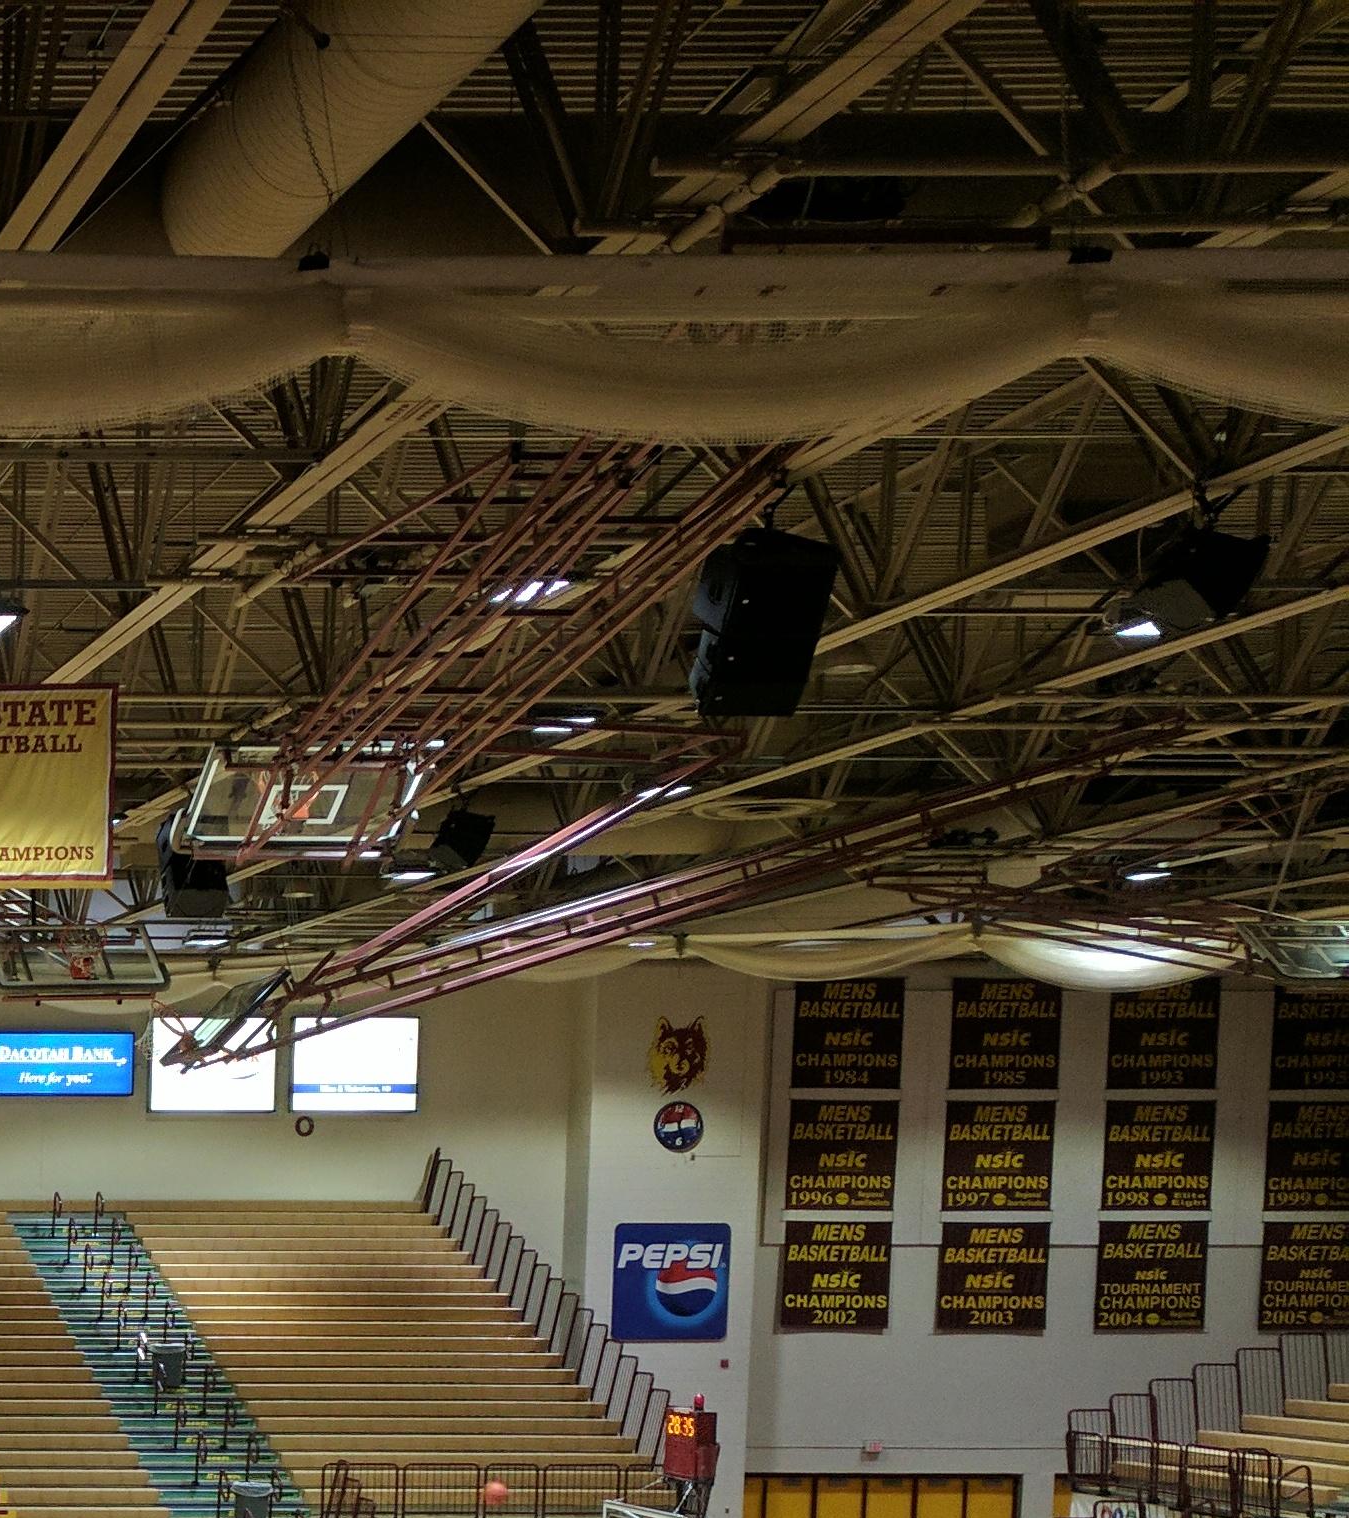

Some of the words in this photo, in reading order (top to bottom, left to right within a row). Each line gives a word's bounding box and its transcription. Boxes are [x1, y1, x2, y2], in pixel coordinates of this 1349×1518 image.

[823, 982, 877, 1000] MENS
[981, 982, 1035, 1000] MENS
[798, 1000, 901, 1018] BASKETBALL
[956, 1000, 1057, 1018] BASKETBALL
[1113, 1002, 1217, 1019] BASKETBALL
[72, 1045, 115, 1061] BANK
[796, 1053, 899, 1068] CHAMPIONS
[953, 1053, 1057, 1069] CHAMPIONS
[1111, 1053, 1215, 1068] CHAMPIONS
[18, 1071, 45, 1084] Here
[824, 1070, 870, 1085] 1984
[982, 1070, 1027, 1085] 1985
[817, 1105, 872, 1122] MENS
[974, 1105, 1028, 1122] MENS
[1133, 1104, 1189, 1122] MENS
[294, 1115, 315, 1137] O
[792, 1123, 894, 1141] BASKETBALL
[949, 1123, 1051, 1141] BASKETBALL
[1108, 1125, 1211, 1142] BASKETBALL
[790, 1175, 892, 1190] CHAMPIONS
[946, 1175, 1049, 1190] CHAMPIONS
[1106, 1176, 1209, 1190] CHAMPIONS
[790, 1191, 834, 1206] 1996
[946, 1192, 990, 1207] 1997
[1106, 1191, 1150, 1207] 1998
[811, 1223, 867, 1242] MENS
[968, 1227, 1024, 1244] MENS
[1127, 1223, 1182, 1240] MENS
[1290, 1224, 1344, 1240] MENS
[617, 1243, 724, 1269] PEPSI
[787, 1245, 889, 1262] BASKETBALL
[943, 1247, 1046, 1263] BASKETBALL
[1102, 1242, 1203, 1259] BASKETBALL
[1102, 1283, 1201, 1295] TOURNAMENT
[784, 1293, 887, 1309] CHAMPIONS
[940, 1294, 1045, 1310] CHAMPIONS
[1099, 1296, 1202, 1310] CHAMPIONS
[811, 1309, 857, 1325] 2002
[968, 1310, 1014, 1325] 2003
[1097, 1311, 1143, 1327] 2004
